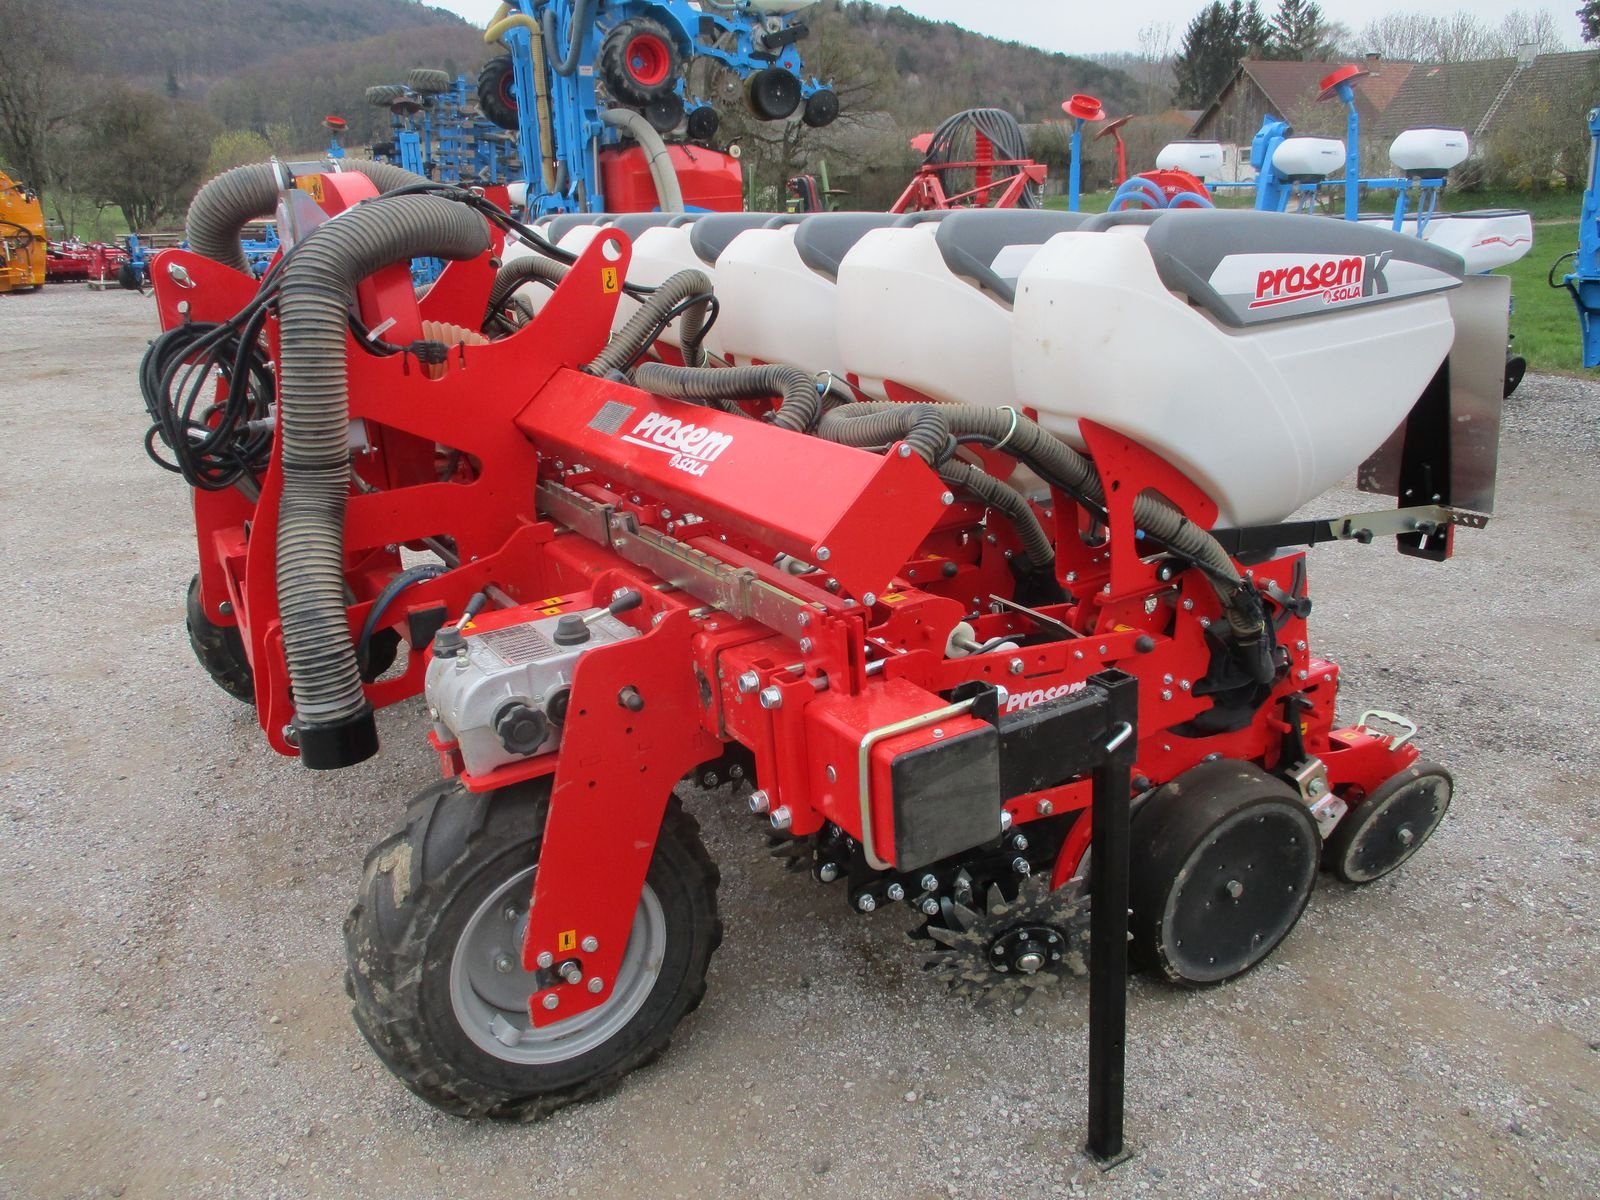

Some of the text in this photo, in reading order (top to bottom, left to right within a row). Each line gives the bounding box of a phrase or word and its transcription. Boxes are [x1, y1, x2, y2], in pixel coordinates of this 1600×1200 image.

[1256, 250, 1392, 298] prosem K
[1332, 286, 1361, 302] SOLA
[632, 412, 734, 462] prosem
[676, 454, 709, 477] SOLA
